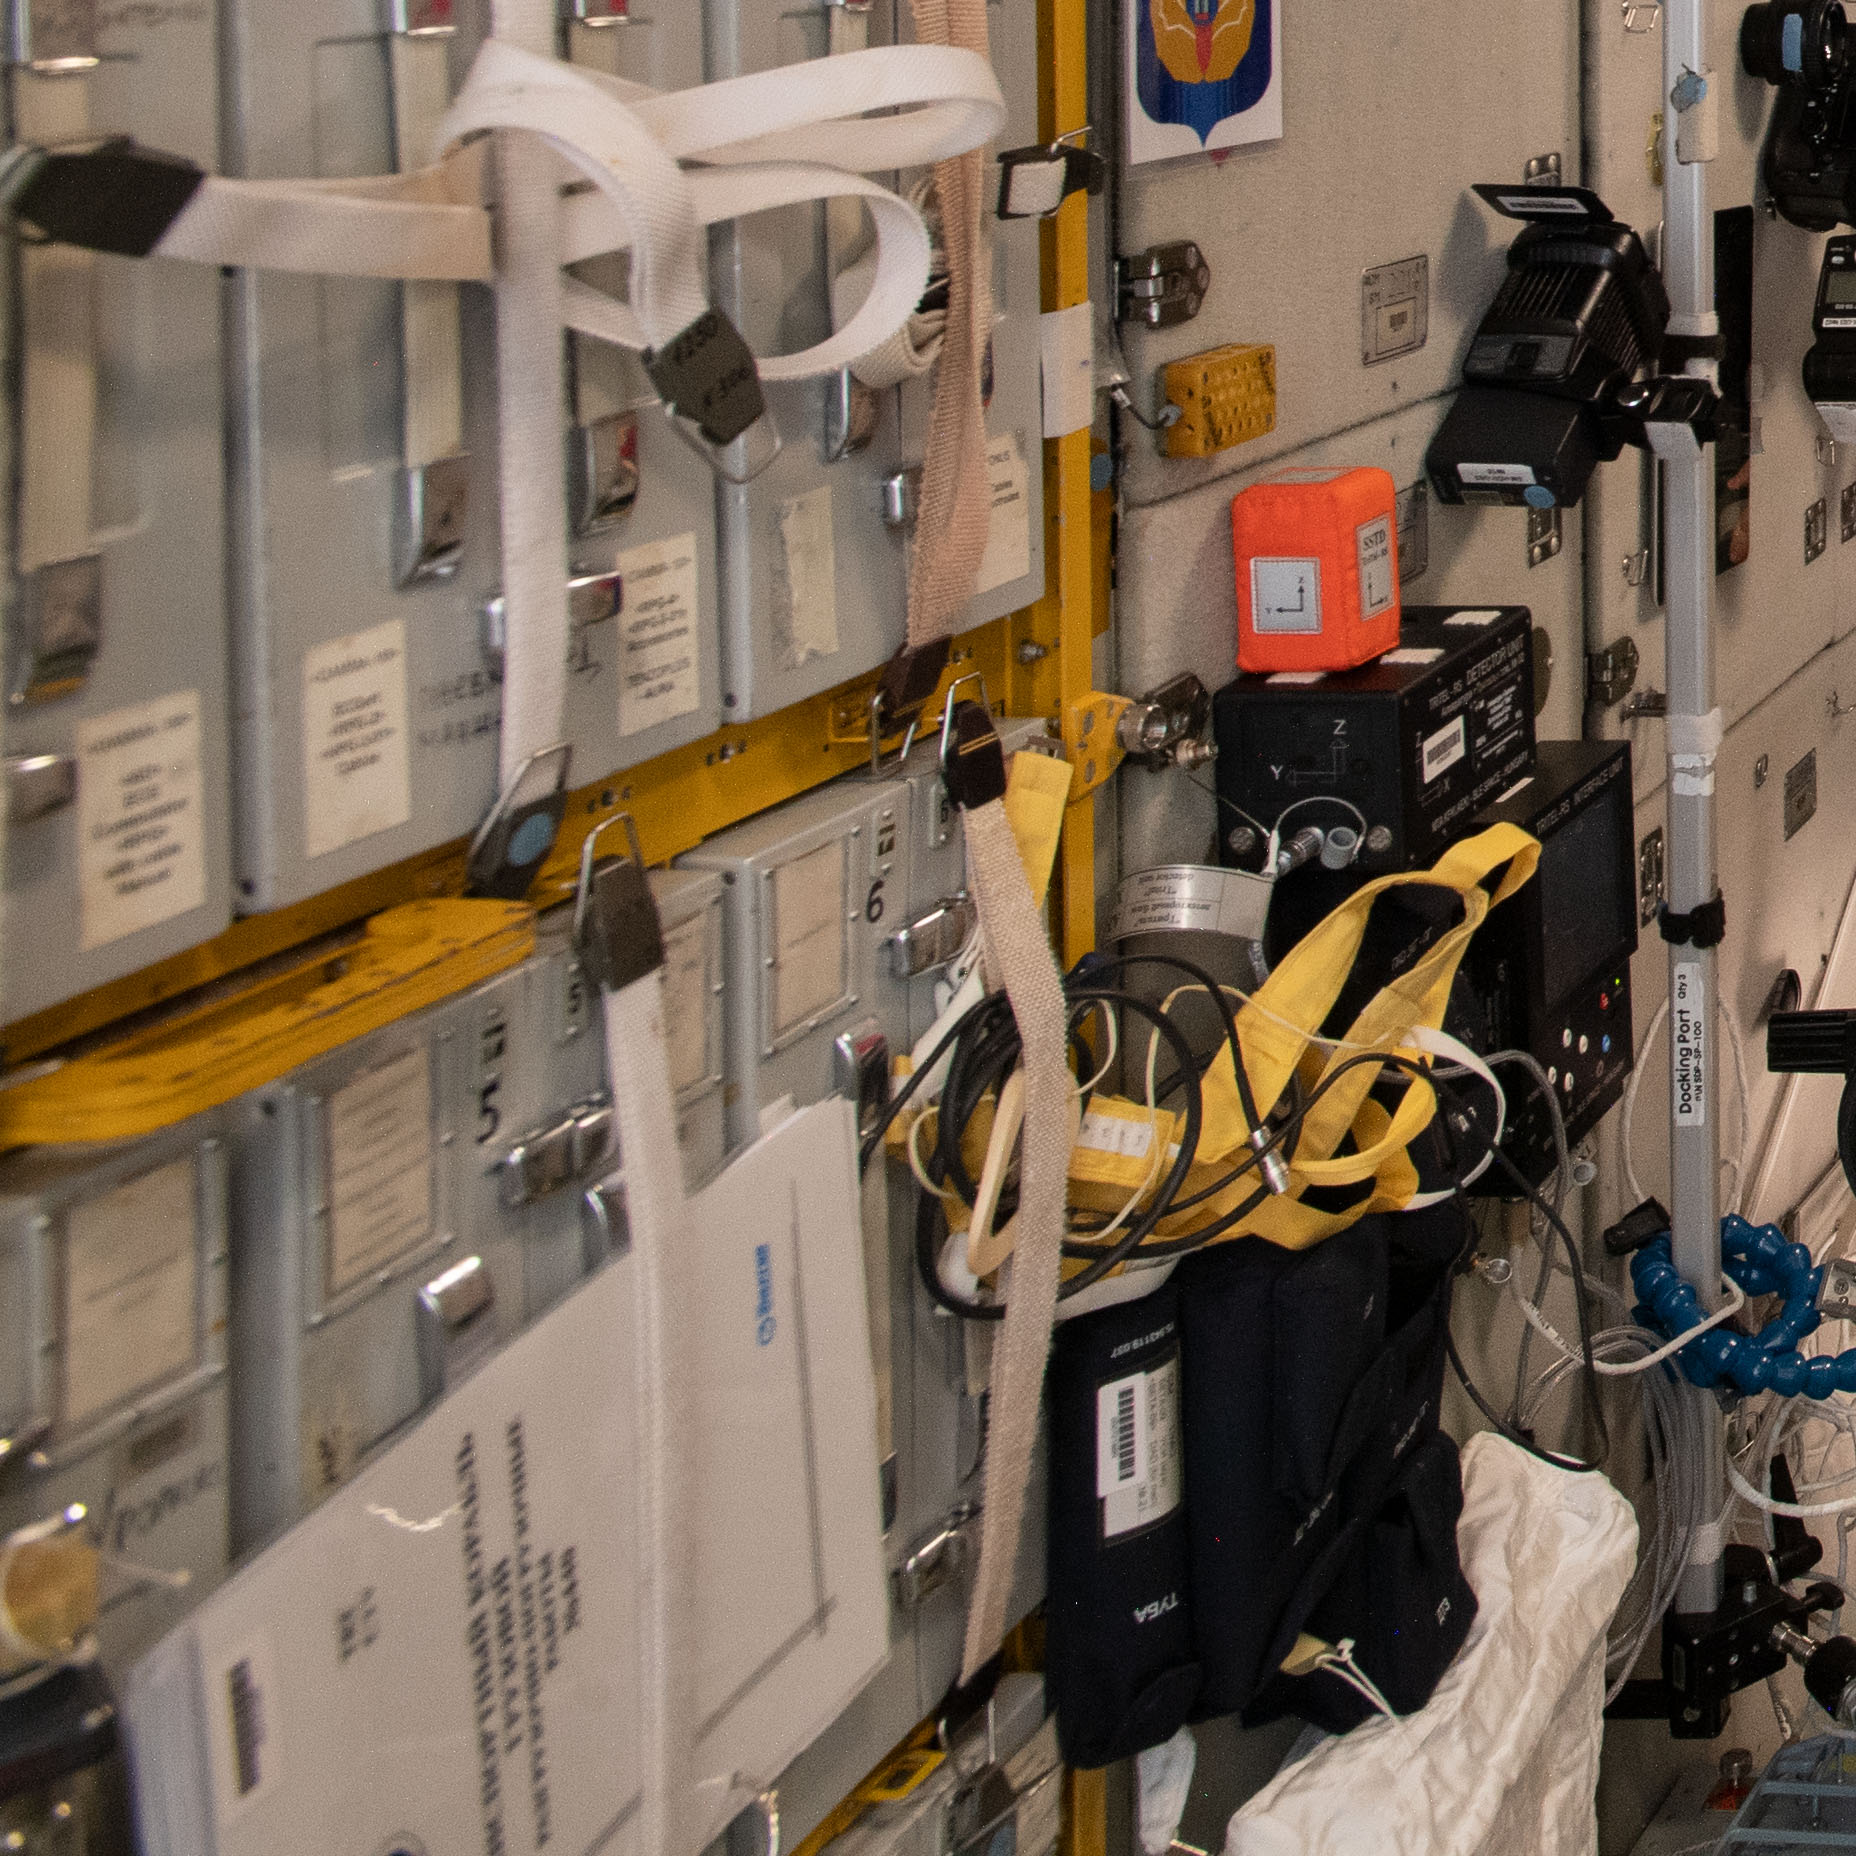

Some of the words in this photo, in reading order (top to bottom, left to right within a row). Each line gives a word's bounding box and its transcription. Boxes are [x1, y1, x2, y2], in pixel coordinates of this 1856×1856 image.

[1363, 528, 1387, 552] SSTD
[1466, 650, 1504, 687] DETECTOR
[1333, 719, 1347, 735] Z
[1270, 764, 1284, 781] Y
[866, 879, 884, 923] 6
[1678, 983, 1687, 1000] Qty
[1678, 1008, 1691, 1052] Port
[1678, 1054, 1692, 1115] Docking
[1130, 1585, 1180, 1629] ТУБА
